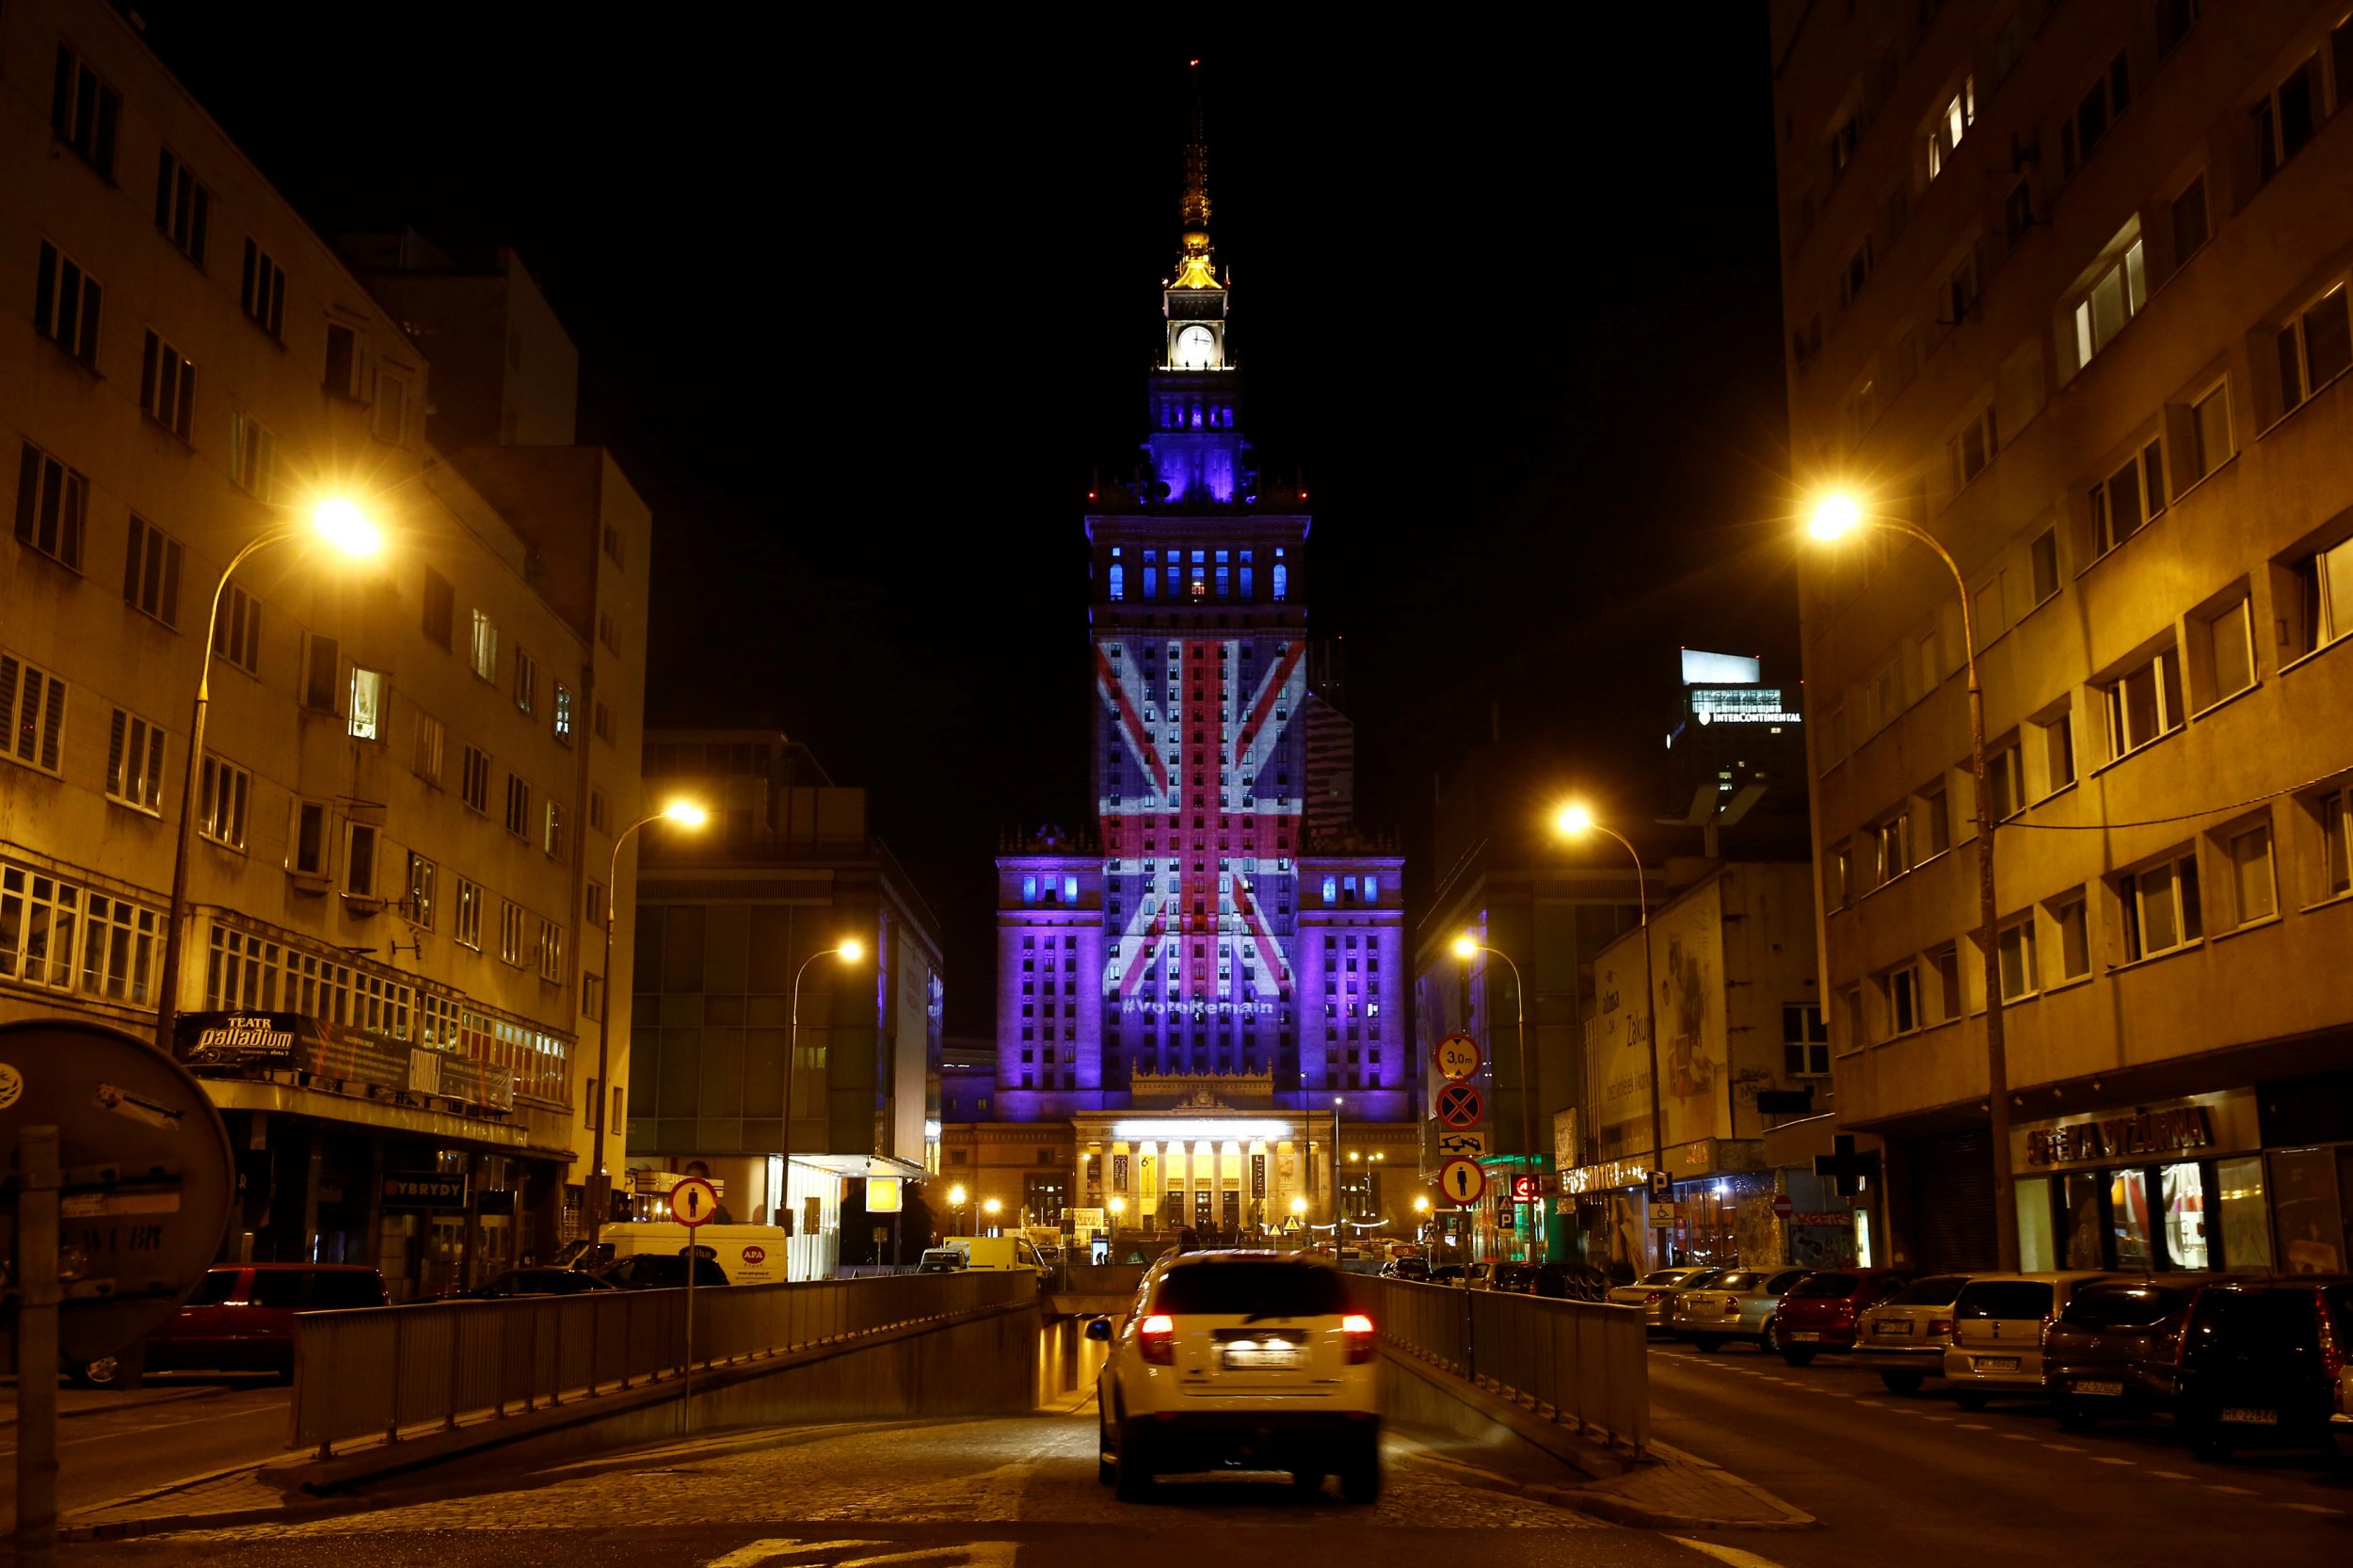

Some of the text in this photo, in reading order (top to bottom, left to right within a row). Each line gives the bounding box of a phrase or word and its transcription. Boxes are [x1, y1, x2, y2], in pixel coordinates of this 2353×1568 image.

[1122, 999, 1273, 1016] #VoteRemain
[1603, 991, 1619, 1015] alma
[228, 1018, 272, 1029] TEATR
[1141, 1157, 1148, 1167] 6
[1653, 1175, 1668, 1194] P
[1501, 1214, 1512, 1227] P
